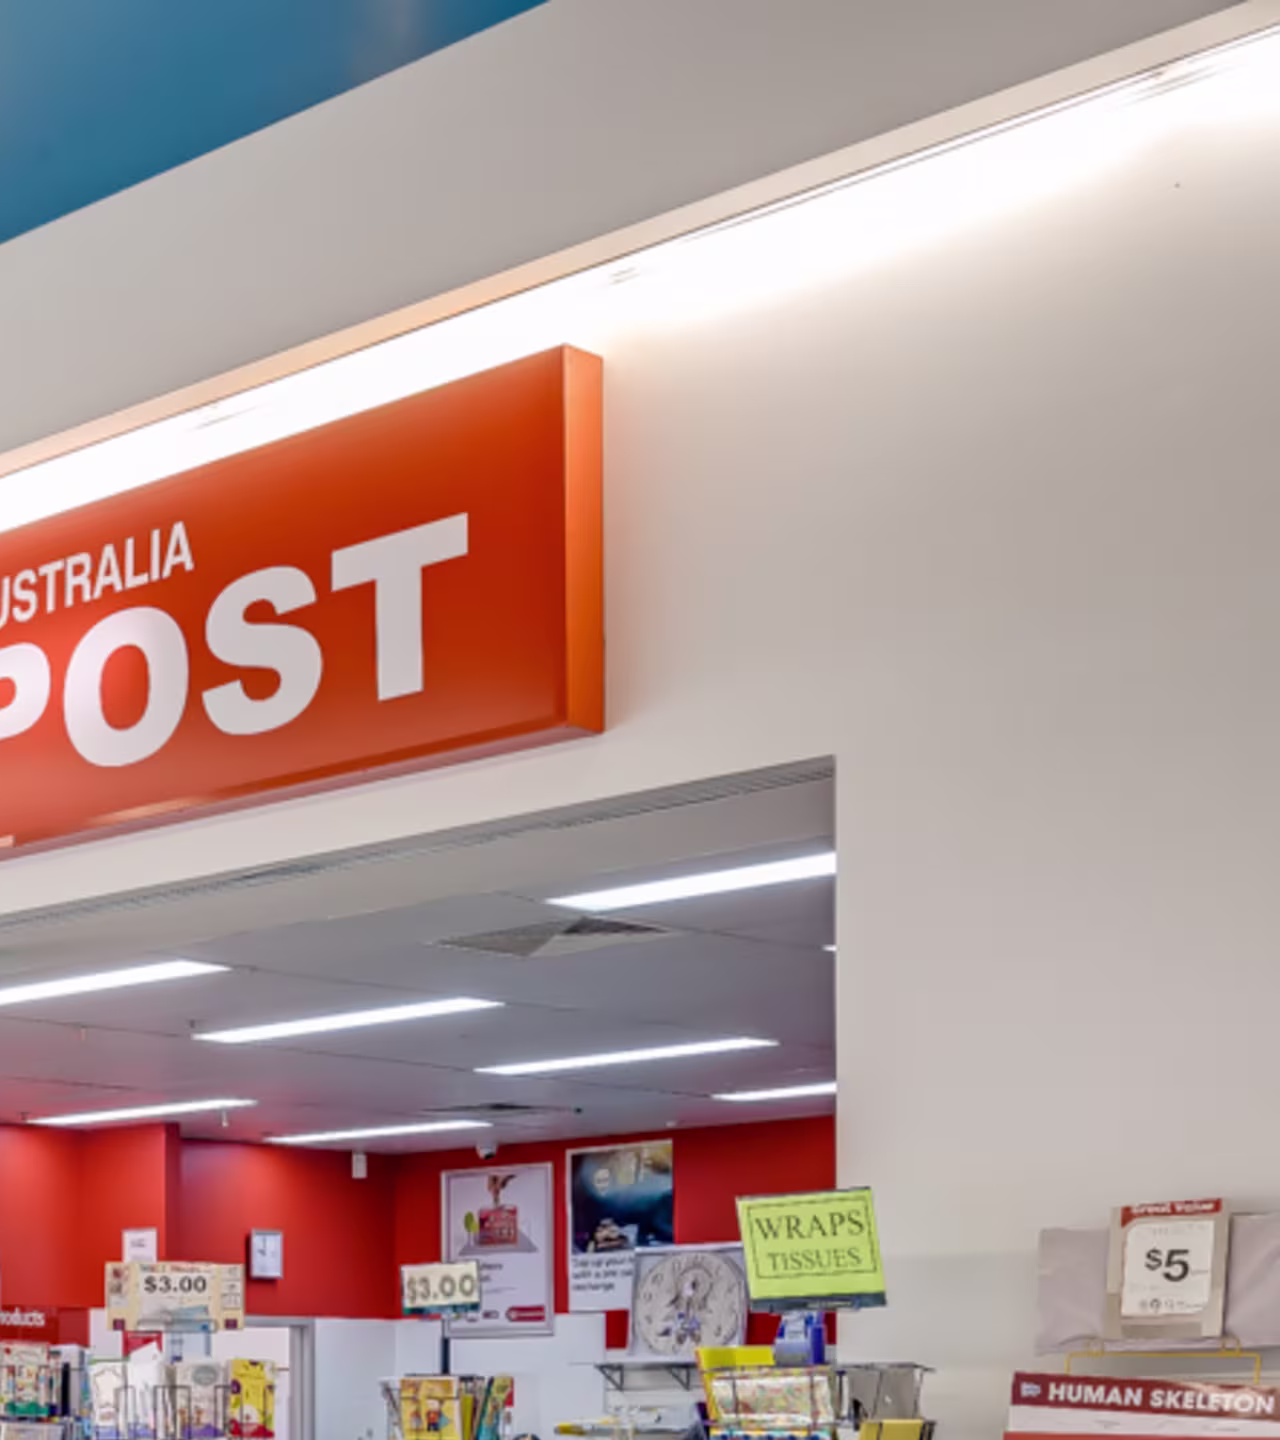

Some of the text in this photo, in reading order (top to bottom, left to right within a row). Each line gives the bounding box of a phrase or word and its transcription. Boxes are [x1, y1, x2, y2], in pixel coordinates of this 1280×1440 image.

[755, 1209, 864, 1239] WRAPS
[767, 1247, 863, 1271] TISSUES
[1144, 1247, 1190, 1282] $5
[144, 1275, 207, 1294] $3.00
[406, 1274, 475, 1303] $3.00
[1048, 1382, 1275, 1414] HUMAN SKELETON
